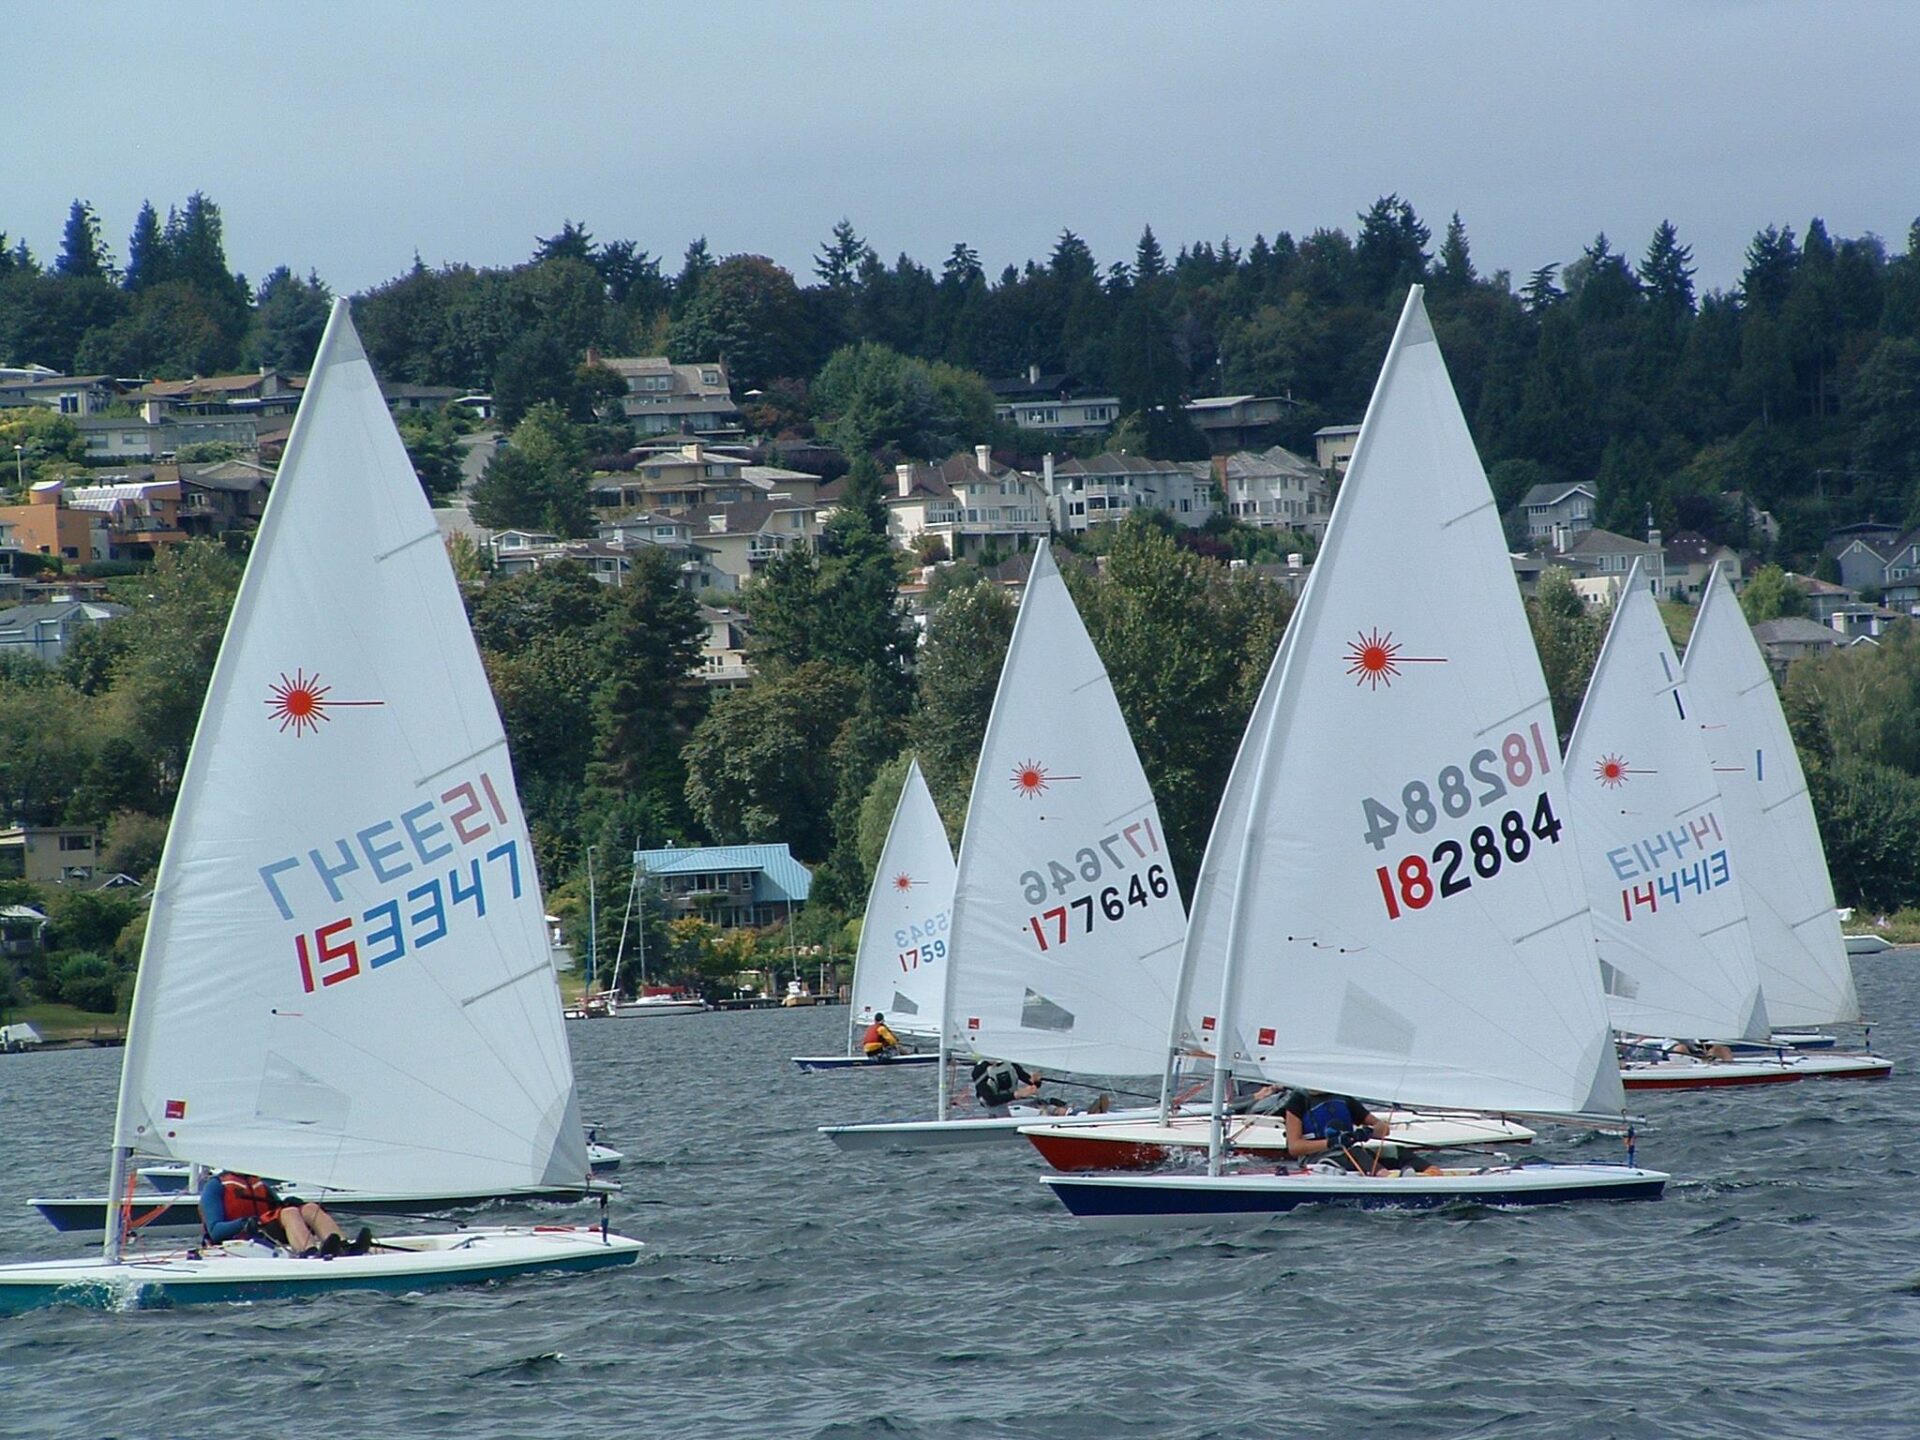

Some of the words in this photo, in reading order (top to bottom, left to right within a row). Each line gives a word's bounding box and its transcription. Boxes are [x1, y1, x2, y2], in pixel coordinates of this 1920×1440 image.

[1376, 791, 1563, 920] 182884
[1622, 849, 1730, 922] 144413
[294, 840, 522, 994] 153347
[1029, 864, 1169, 951] 177646
[899, 939, 946, 973] 1759
